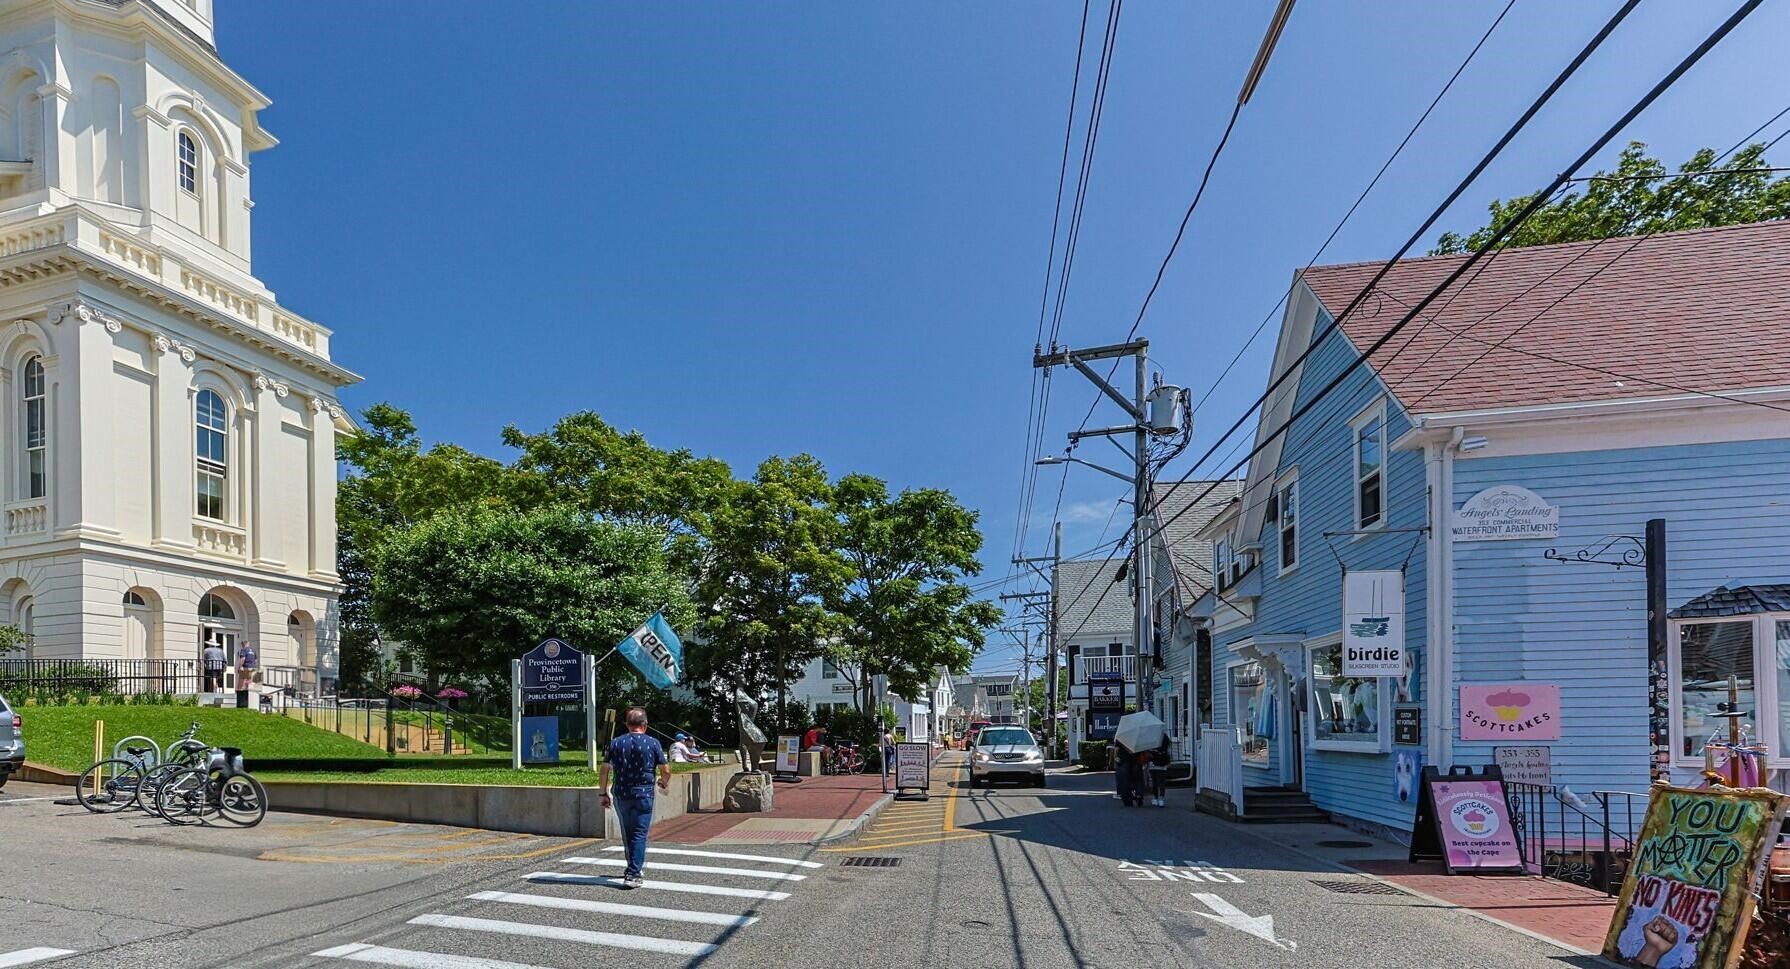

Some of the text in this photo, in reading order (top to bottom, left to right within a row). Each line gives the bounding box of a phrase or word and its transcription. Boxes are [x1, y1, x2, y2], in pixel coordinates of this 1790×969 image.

[1504, 504, 1552, 519] Landing
[1452, 523, 1558, 535] WATERFRONT APARTMENTS
[1348, 647, 1399, 661] birdie
[528, 658, 577, 666] Provincetown
[541, 665, 564, 673] Public
[540, 674, 566, 683] Library
[1465, 710, 1551, 732] SCOTTCAKES
[1453, 801, 1494, 816] SCOTTCAKES
[1670, 798, 1747, 833] YOU
[1470, 840, 1500, 848] cupcake
[1635, 827, 1741, 889] MATTER
[1631, 875, 1720, 933] NO KINGS
